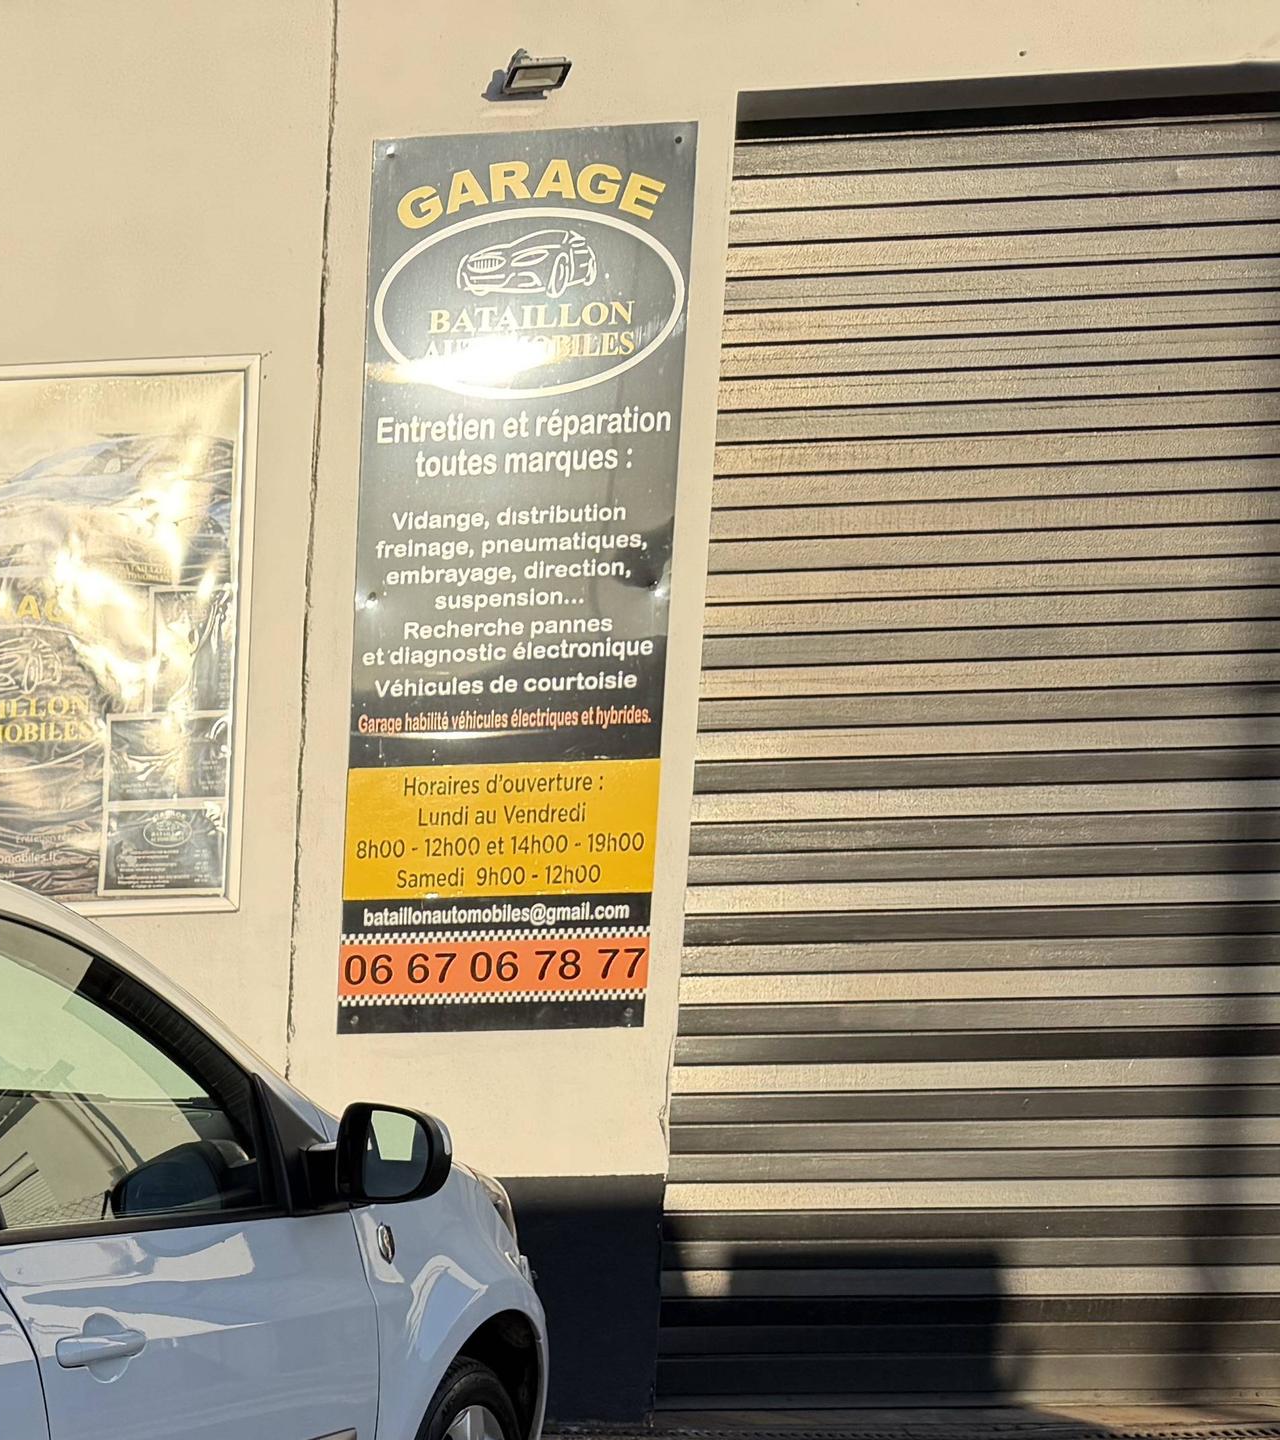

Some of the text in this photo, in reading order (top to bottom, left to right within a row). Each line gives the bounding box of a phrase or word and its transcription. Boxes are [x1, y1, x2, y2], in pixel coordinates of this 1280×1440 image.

[397, 159, 666, 229] GARAGE
[428, 300, 636, 335] BATAILLON
[376, 406, 672, 444] Entretien et réparation
[416, 450, 498, 478] toutes
[504, 447, 619, 478] marques
[392, 503, 627, 532] Vidange, distribution
[375, 531, 648, 560] freinage, pneumatiques,
[386, 558, 632, 586] embrayage, direction,
[434, 588, 585, 612] suspension...
[403, 616, 613, 640] Recherche pannes
[362, 637, 654, 669] et diagnostic électronique
[375, 671, 638, 698] Véhicules de courtoisie
[358, 704, 651, 734] Garage habilité véhicules électriques et hybrides.
[403, 777, 480, 797] Horaires
[417, 802, 587, 827] Lundi au Vendredi
[356, 838, 405, 859] 8h00
[424, 836, 481, 857] 12h00
[486, 835, 505, 855] et
[510, 834, 568, 855] 14h00
[587, 832, 645, 852] 19h00
[396, 867, 465, 888] Samedi
[476, 866, 525, 887] 9h00
[544, 864, 602, 885] 12h00
[363, 901, 631, 927] bataillonautomobiles@gmail.com
[344, 947, 646, 986] 06 67 06 78 77
